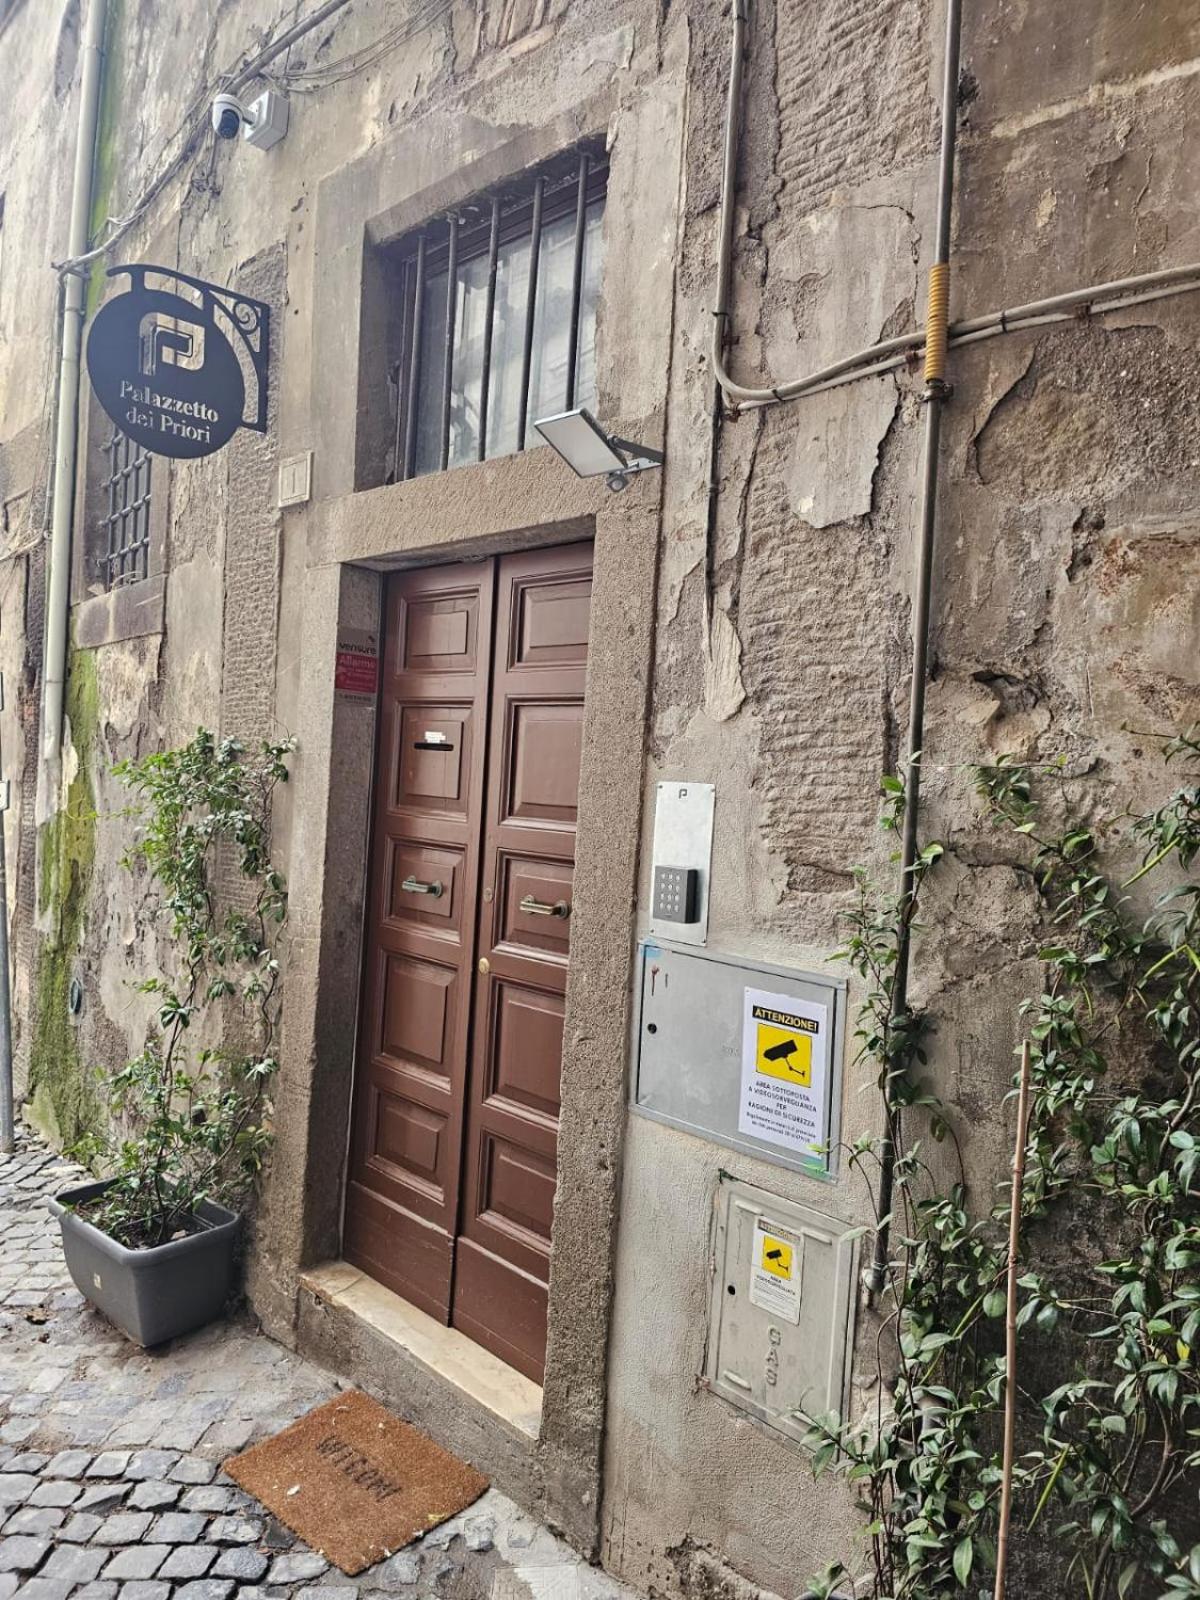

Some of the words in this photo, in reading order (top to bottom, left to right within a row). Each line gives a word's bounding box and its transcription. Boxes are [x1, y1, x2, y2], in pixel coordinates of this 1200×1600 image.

[119, 379, 219, 423] Palazzetto
[126, 406, 154, 428] dei
[160, 414, 211, 444] Priori
[754, 1007, 817, 1032] ATTENZIONE!
[756, 1081, 770, 1090] AREA
[772, 1085, 811, 1102] SOTTOPOSTA
[748, 1101, 773, 1114] RAGIONI
[782, 1112, 816, 1127] SICUREZZA
[776, 1102, 788, 1110] PER
[766, 1327, 782, 1386] GAS
